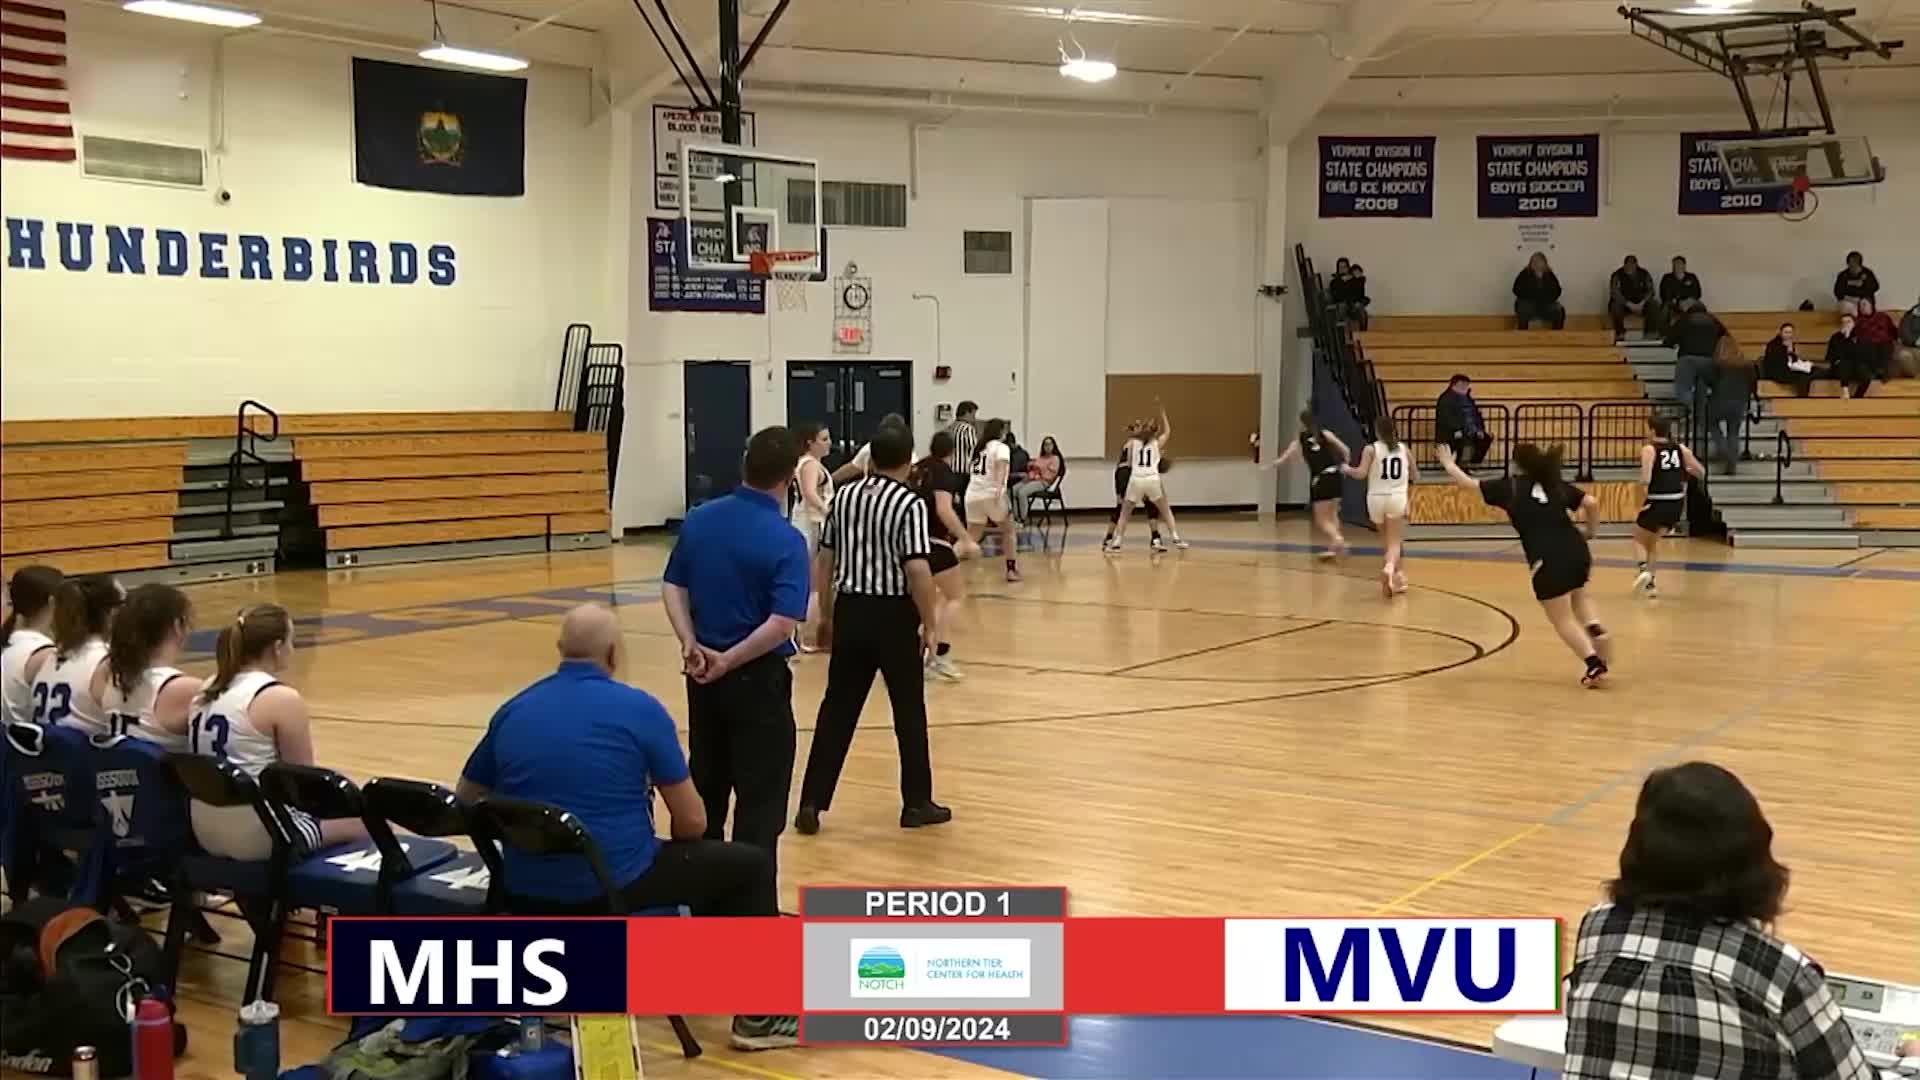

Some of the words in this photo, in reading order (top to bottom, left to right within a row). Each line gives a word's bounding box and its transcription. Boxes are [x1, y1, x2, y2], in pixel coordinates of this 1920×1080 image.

[1330, 144, 1371, 157] VERMONT
[1374, 145, 1411, 157] DIVISION
[1492, 143, 1533, 157] VERMONT
[1536, 144, 1573, 156] DIVISION
[1325, 161, 1363, 177] STATE
[1365, 161, 1428, 178] CHAMPIONS
[1487, 161, 1523, 177] STATE
[1525, 160, 1588, 177] CHAMPIONS
[1325, 181, 1358, 193] GIRLS
[1360, 181, 1380, 194] ICE
[1382, 181, 1426, 194] HOCKEY
[1490, 181, 1526, 194] BOYS
[1528, 180, 1585, 193] SOCCER
[1689, 177, 1720, 191] BOYS
[1518, 197, 1558, 210] 2010
[1720, 194, 1762, 208] 2010
[6, 217, 457, 286] HUNDERBIRDS
[973, 456, 987, 475] 21
[1138, 450, 1151, 467] 11
[1660, 450, 1680, 470] 24
[1381, 457, 1402, 480] 10
[1531, 482, 1549, 504] 4
[33, 682, 72, 724] 22
[191, 712, 229, 758] 13
